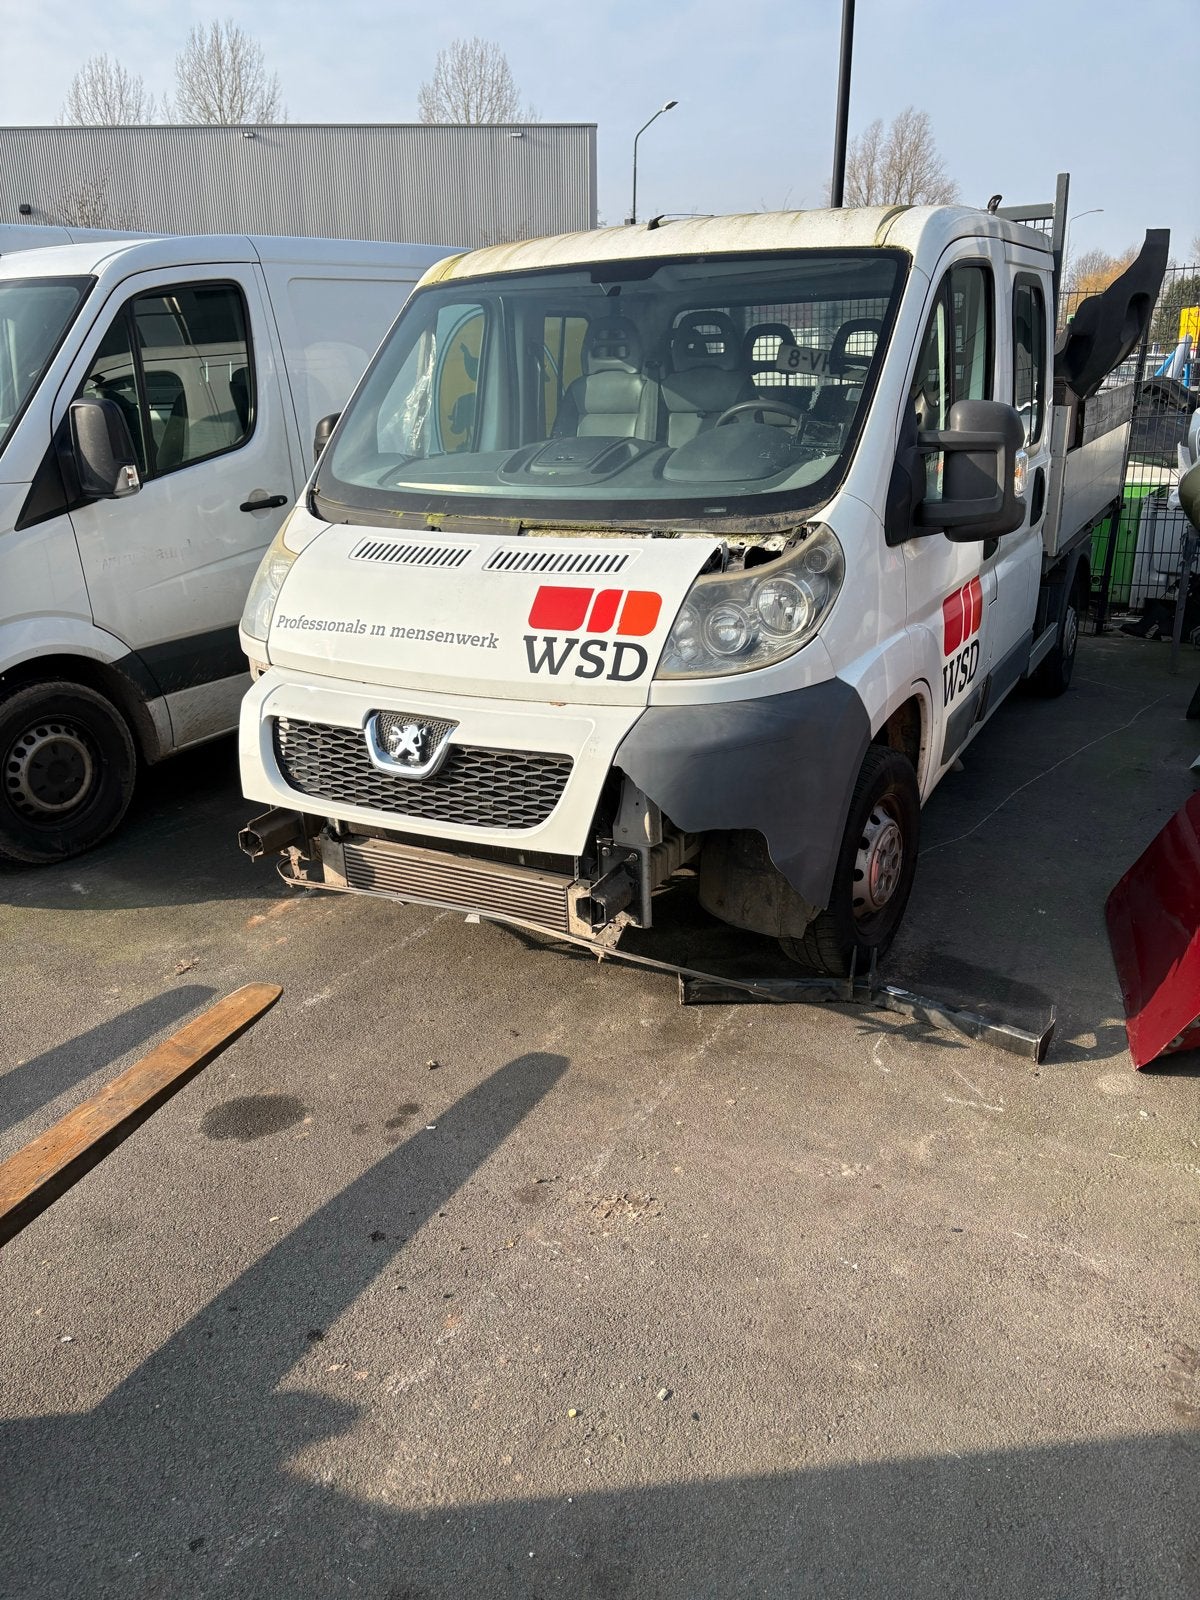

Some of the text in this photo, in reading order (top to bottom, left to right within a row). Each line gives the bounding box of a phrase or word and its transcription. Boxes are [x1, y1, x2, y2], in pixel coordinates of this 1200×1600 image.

[276, 614, 500, 649] Professionals in mensenwerk
[523, 635, 648, 681] WSD
[943, 639, 980, 707] WSD
